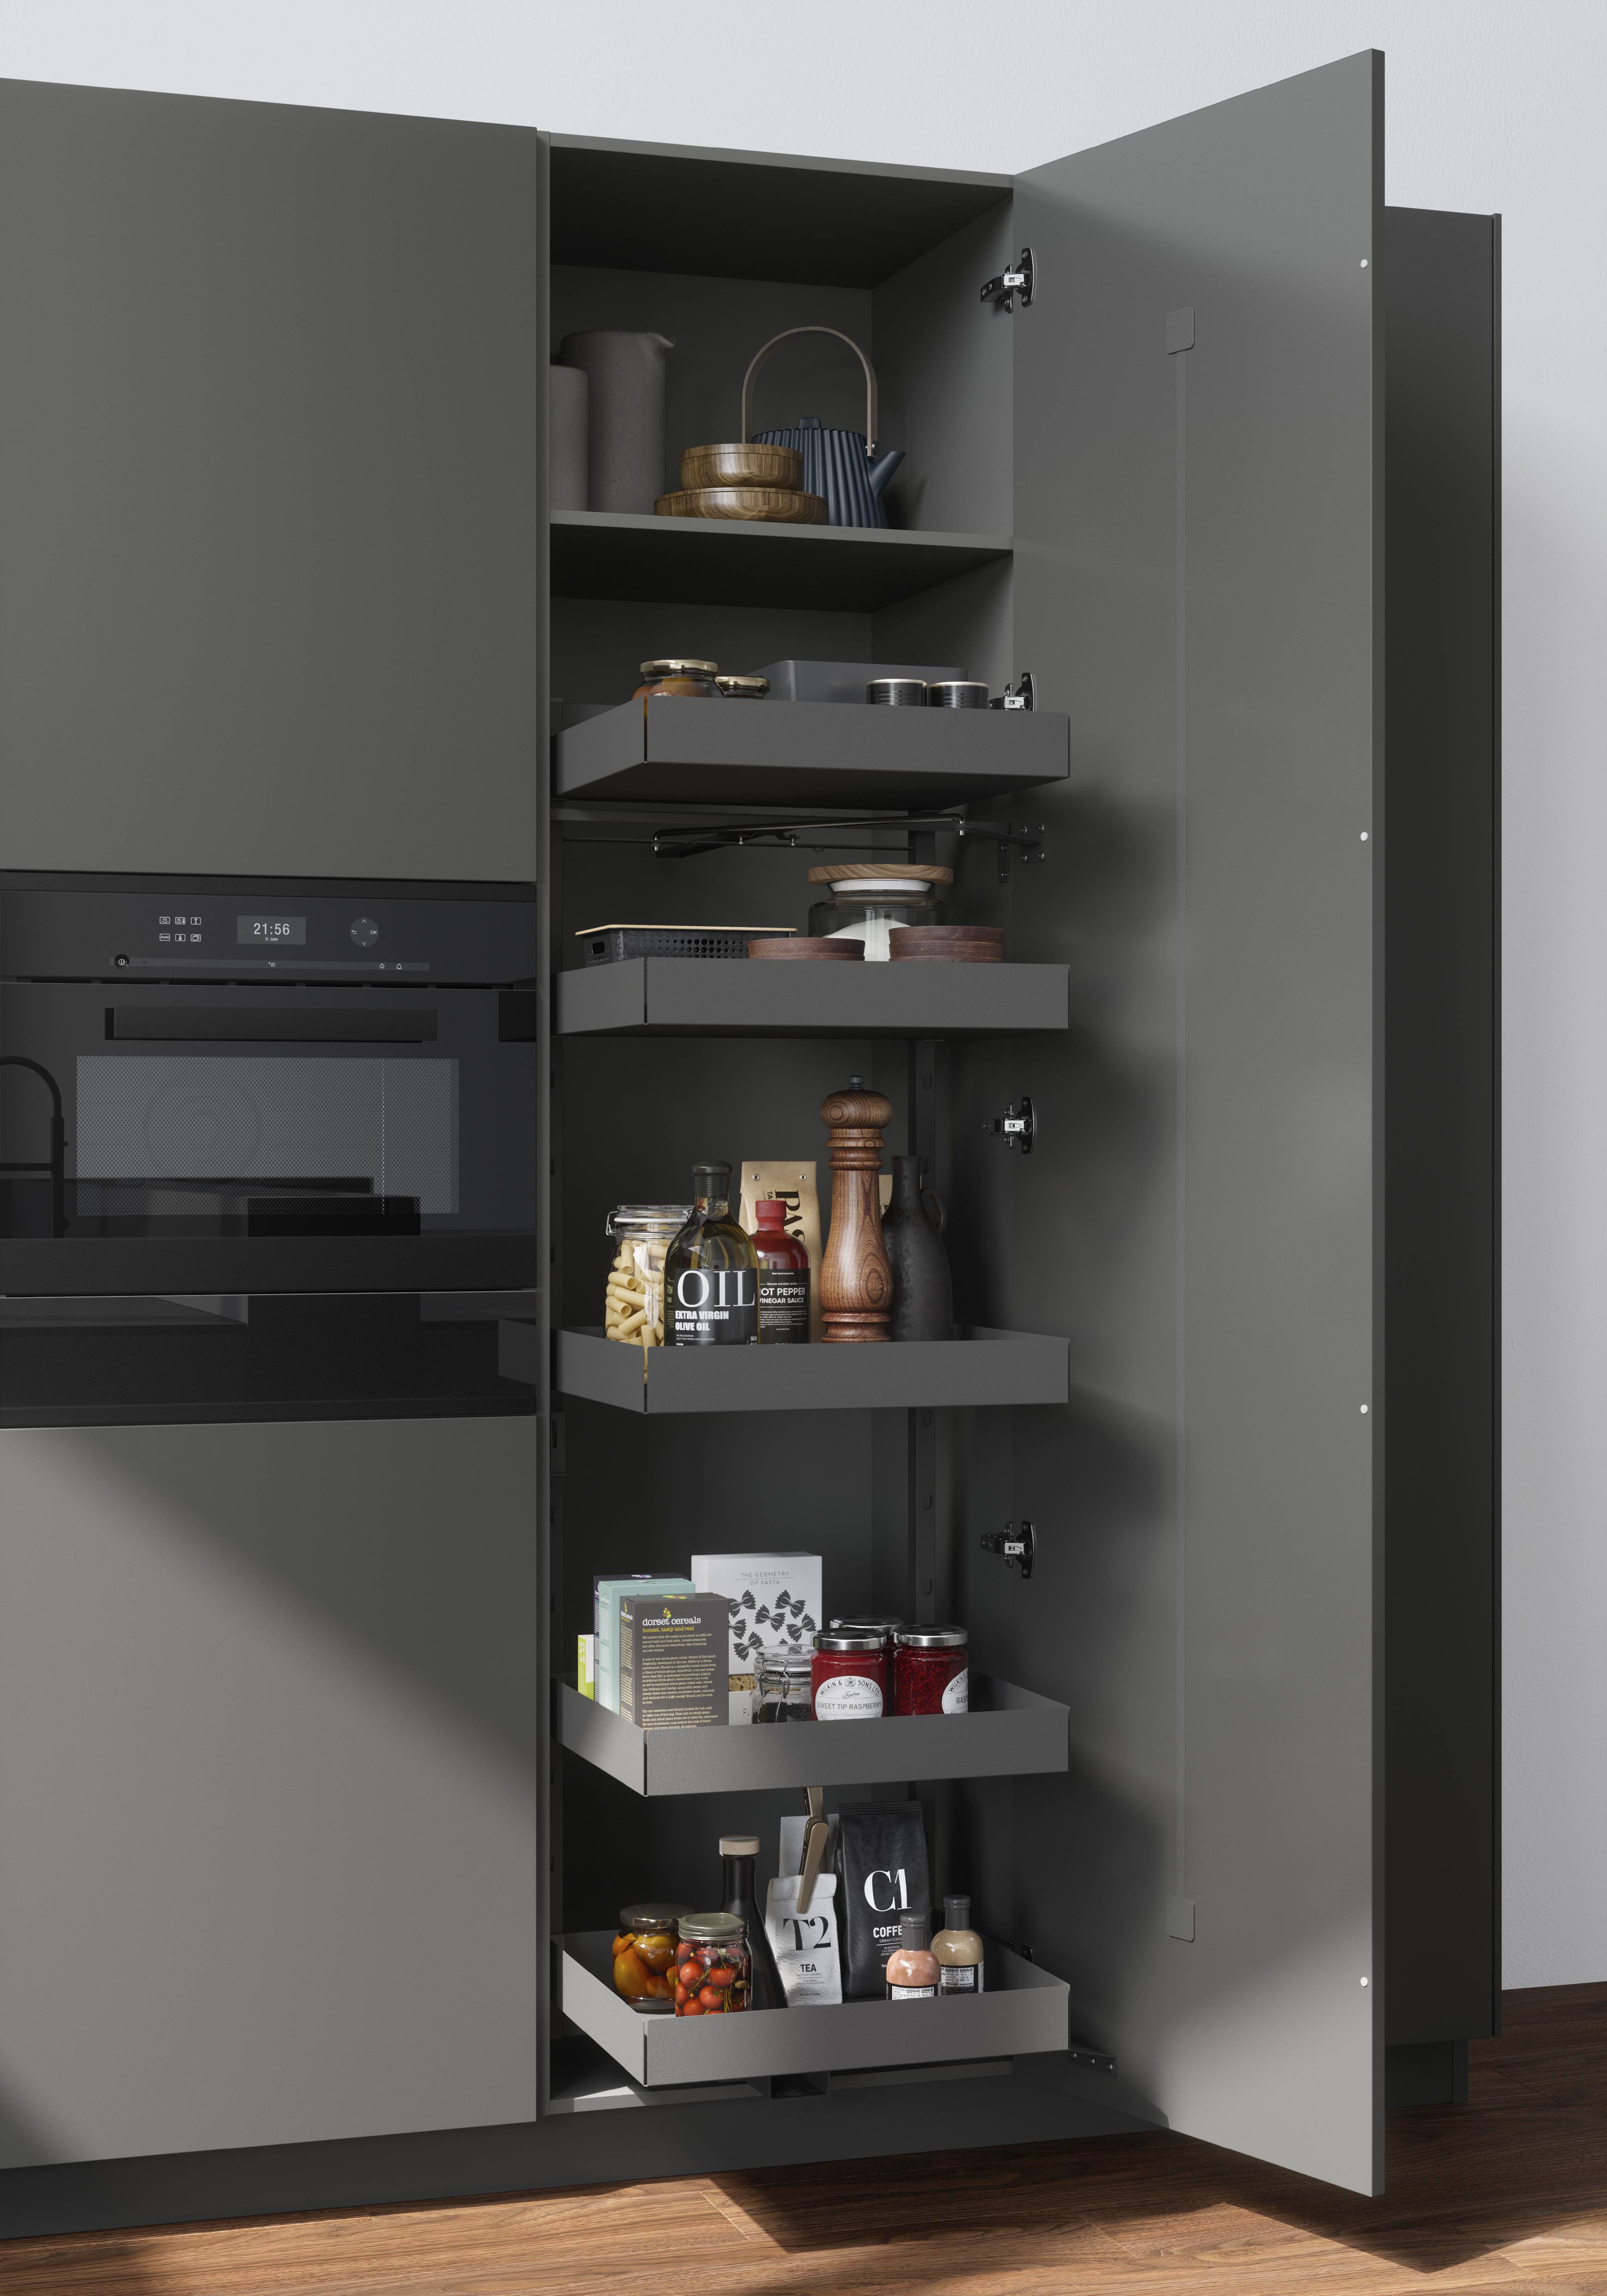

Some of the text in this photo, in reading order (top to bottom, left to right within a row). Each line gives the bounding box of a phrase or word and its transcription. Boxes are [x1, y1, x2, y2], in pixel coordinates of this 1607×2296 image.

[254, 923, 289, 935] 21:56
[678, 1270, 755, 1307] OIL
[777, 1287, 805, 1296] PEPPER
[675, 1311, 698, 1319] EXTRA
[699, 1311, 729, 1319] VIRGIN
[675, 1322, 710, 1331] OLIVE OIL
[671, 1617, 701, 1625] cereals
[820, 1681, 837, 1696] WILKIN
[858, 1680, 872, 1689] SONS
[949, 1676, 962, 1692] WILKIN
[864, 1869, 912, 1912] C1
[783, 1916, 831, 1951] T2
[873, 1925, 902, 1938] COFFE
[800, 1964, 817, 1972] TEA
